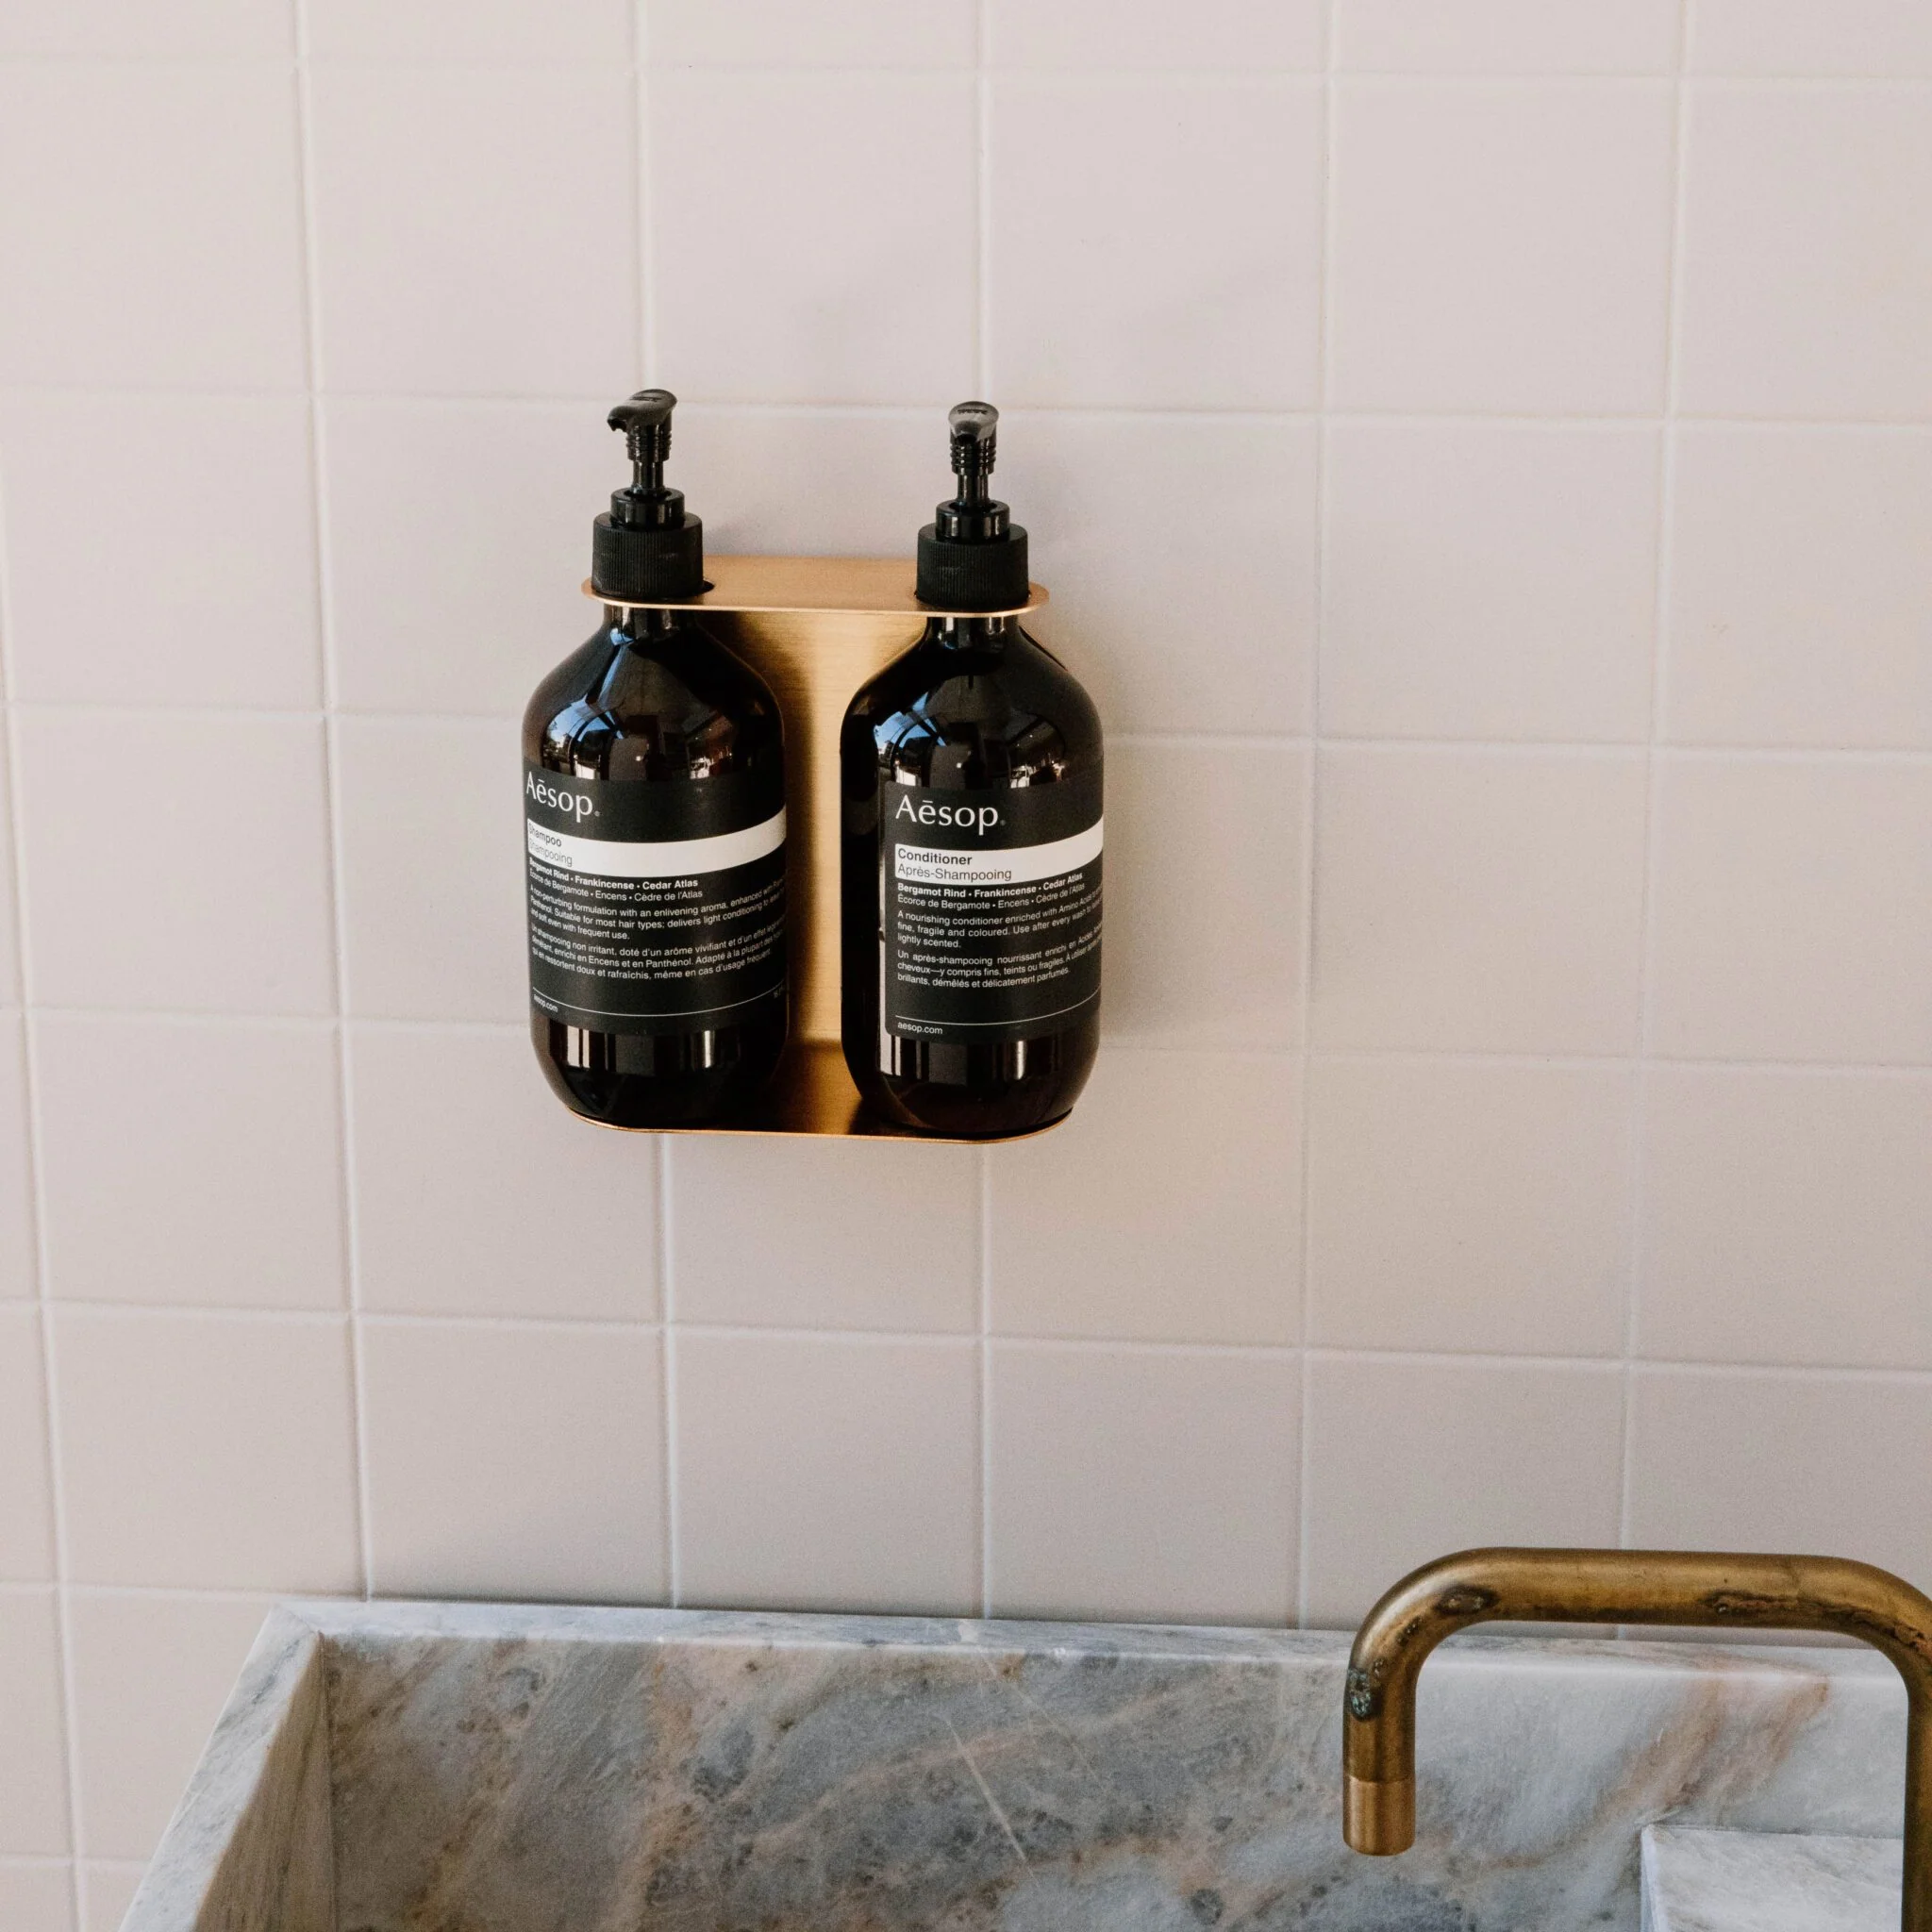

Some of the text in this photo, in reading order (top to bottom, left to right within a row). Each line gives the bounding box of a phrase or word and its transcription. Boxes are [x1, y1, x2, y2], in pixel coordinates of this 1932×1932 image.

[898, 848, 973, 865] Conditioner
[553, 869, 569, 881] Rind
[575, 875, 635, 891] Frankincense
[642, 881, 672, 890] Cedar
[674, 879, 698, 889] Atlas
[898, 863, 1011, 881] Après-Shampooing
[552, 880, 589, 894] Bergamote
[595, 891, 627, 901] Encens
[634, 892, 662, 901] Cèdre
[677, 890, 703, 899] l'Atlas
[898, 873, 1083, 898] Bergamot Rind Frankincense Cedar Atlas
[574, 902, 617, 916] formulation
[619, 908, 638, 917] with
[654, 907, 698, 916] enlivening
[730, 891, 762, 907] enhanced
[898, 892, 925, 907] Écorce
[928, 899, 939, 908] de
[941, 900, 991, 911] Bergamote
[998, 898, 1030, 908] Encens
[1036, 893, 1058, 904] Cèdre
[1059, 890, 1068, 898] de
[554, 908, 581, 922] Suitable
[583, 916, 593, 924] for
[595, 918, 616, 927] most
[618, 919, 635, 928] hair
[667, 919, 701, 927] delivers
[704, 914, 721, 924] light
[723, 902, 762, 921] conditioning
[906, 913, 950, 926] nourishing
[952, 917, 1003, 925] conditioner
[1005, 910, 1041, 924] enriched
[1042, 908, 1057, 917] with
[563, 921, 576, 932] with
[577, 925, 609, 938] frequent
[917, 924, 944, 937] fragile
[947, 928, 965, 937] and
[1012, 925, 1030, 934] Use
[1032, 922, 1050, 931] after
[1052, 915, 1071, 925] every
[573, 942, 587, 951] non
[619, 947, 640, 957] doté
[641, 947, 662, 957] d'un
[664, 946, 693, 956] arôme
[694, 941, 726, 954] vivifiant
[728, 939, 736, 947] et
[898, 932, 961, 948] lightly scented.
[554, 948, 576, 960] enrichi
[588, 955, 620, 967] Encens
[695, 953, 725, 966] Adapté
[898, 950, 909, 958] Un
[912, 954, 993, 967] après-shampooing
[997, 951, 1041, 964] nourrissant
[576, 965, 595, 975] doux
[654, 971, 683, 979] même
[698, 967, 713, 975] cas
[715, 958, 745, 972] d'usage
[946, 969, 982, 977] compris
[1004, 966, 1026, 975] teints
[932, 978, 970, 988] démêlés
[982, 975, 1036, 988] délicatement
[898, 1022, 943, 1035] aesop.com
